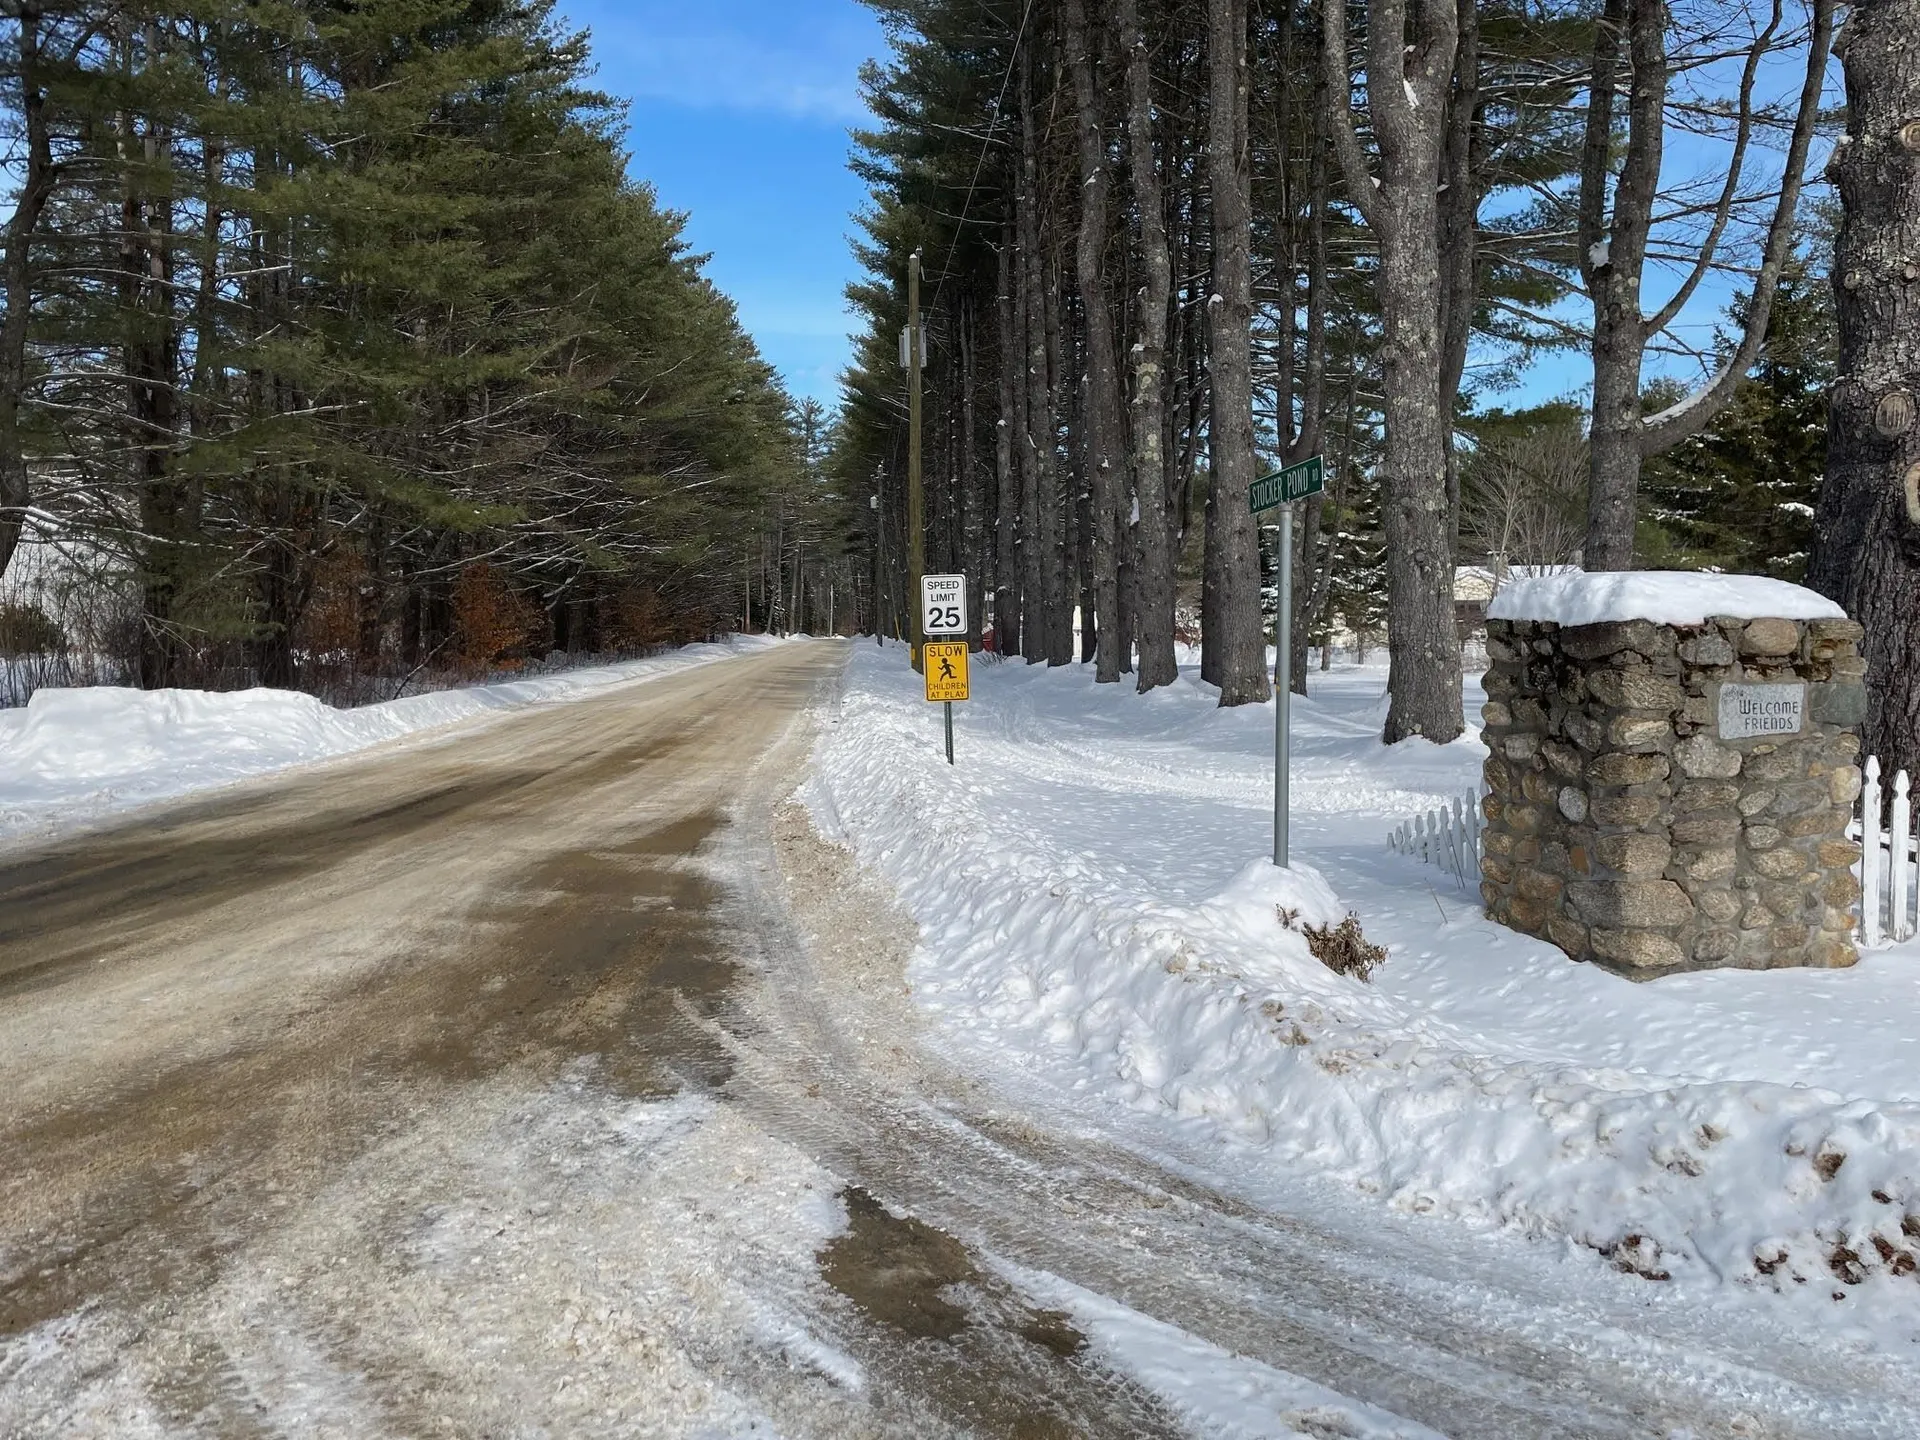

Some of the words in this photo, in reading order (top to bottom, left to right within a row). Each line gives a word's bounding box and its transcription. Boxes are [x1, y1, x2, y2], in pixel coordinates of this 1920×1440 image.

[1252, 477, 1283, 509] STOCKER
[1287, 467, 1309, 497] POND
[927, 580, 959, 590] SPEED
[930, 593, 956, 602] LIMIT
[928, 606, 960, 628] 25
[929, 645, 962, 657] SLOW
[928, 682, 966, 691] CHILDREN
[930, 691, 940, 699] AT
[944, 690, 965, 698] PLAY
[1739, 699, 1798, 715] WELCOME
[1744, 716, 1793, 730] FRIENDS
